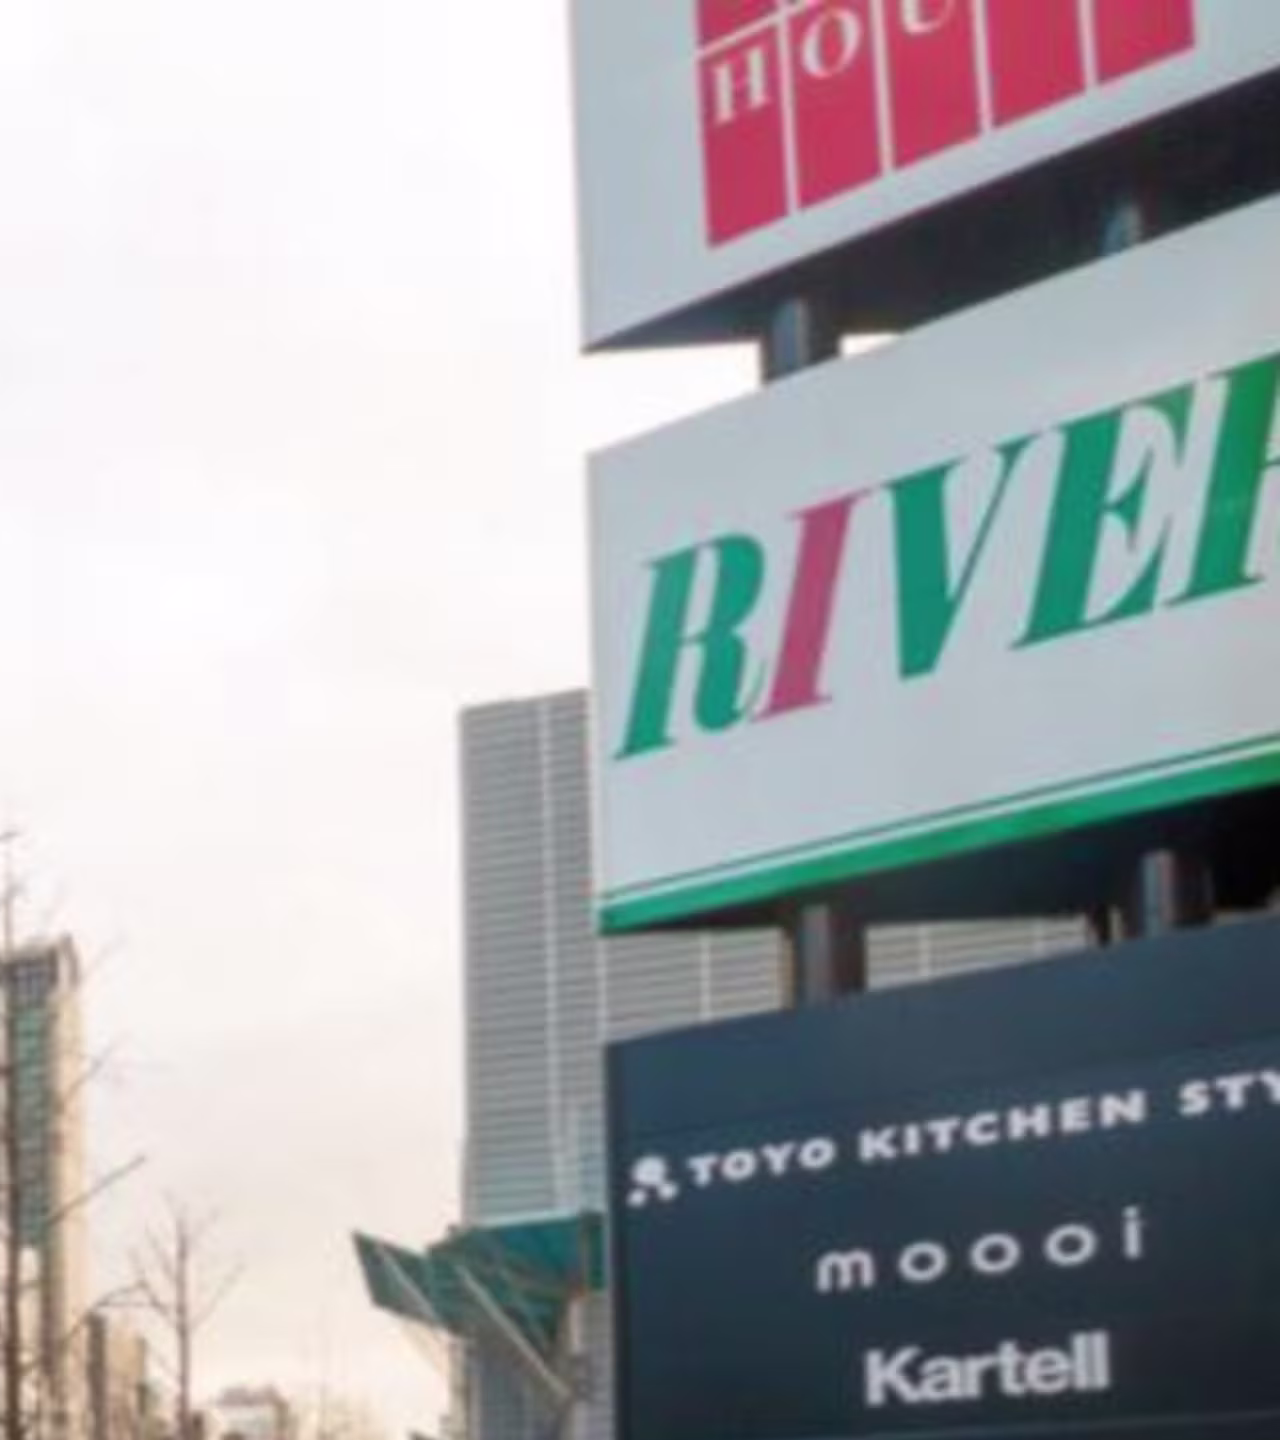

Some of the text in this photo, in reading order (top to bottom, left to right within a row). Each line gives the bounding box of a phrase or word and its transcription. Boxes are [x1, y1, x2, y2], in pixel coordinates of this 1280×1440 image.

[687, 1136, 837, 1187] TOYO
[858, 1088, 1146, 1163] KITCHEN
[814, 1204, 1143, 1294] moooi
[863, 1327, 1111, 1407] Kartell
